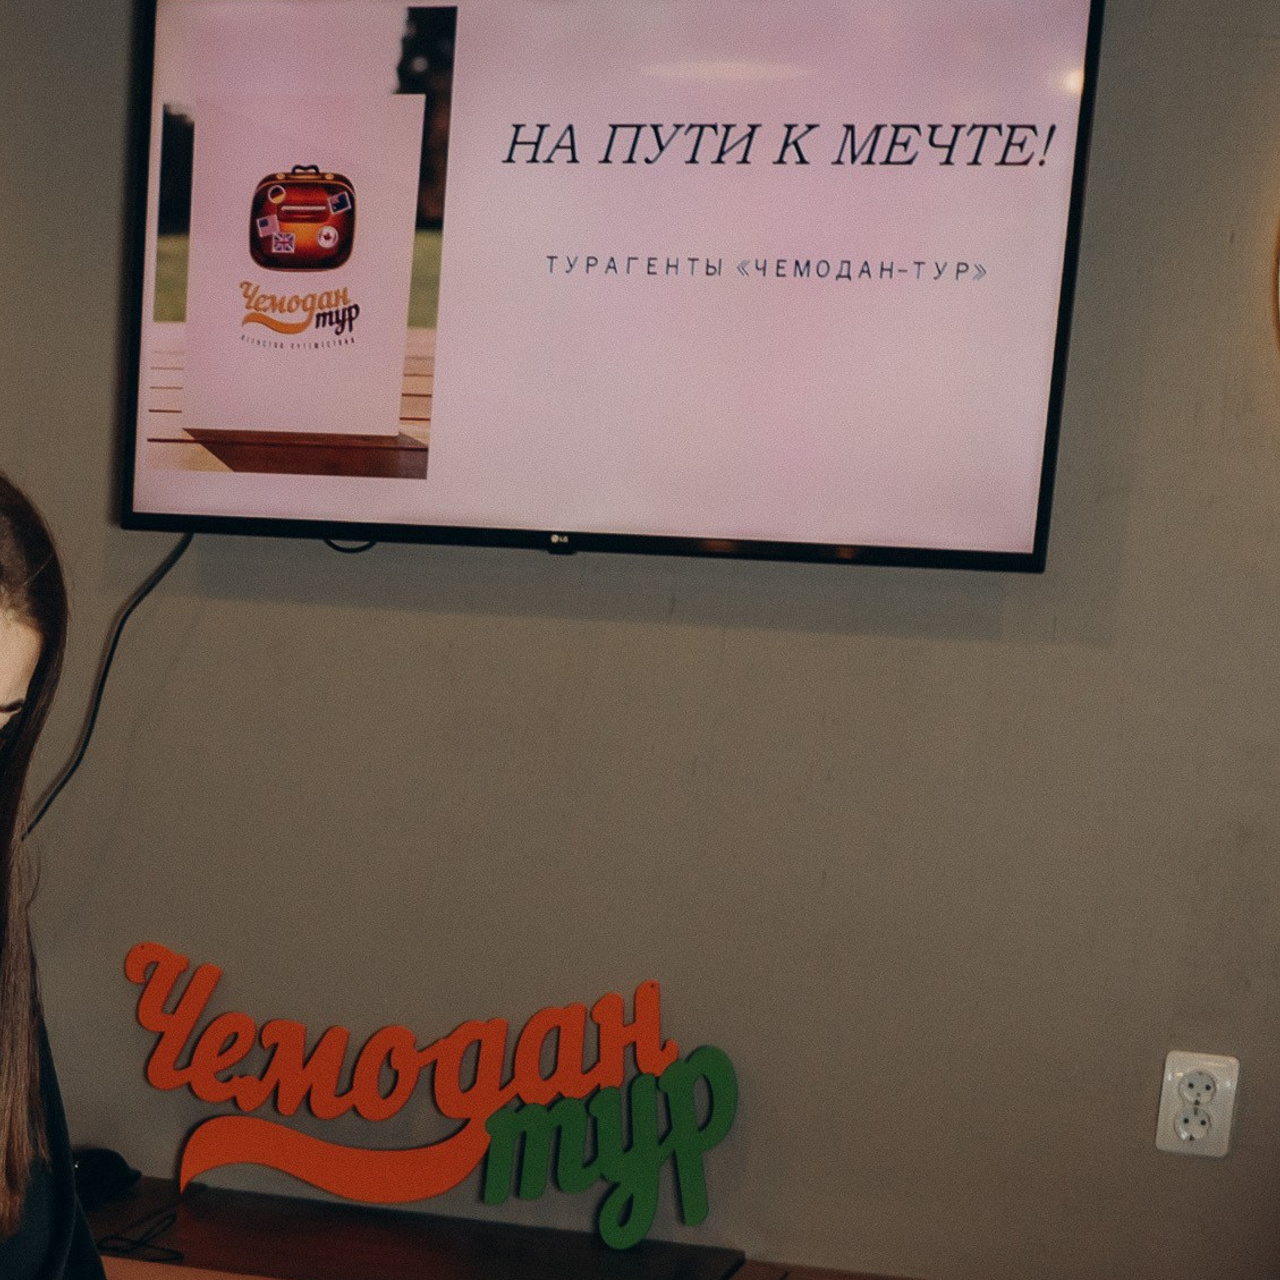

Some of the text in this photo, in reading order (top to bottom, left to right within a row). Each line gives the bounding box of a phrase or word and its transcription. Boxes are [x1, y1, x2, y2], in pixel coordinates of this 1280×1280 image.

[502, 123, 1058, 167] НА ПУТИ К МЕЧТЕ!
[546, 254, 989, 281] ТУРАГЕНТЫ «ЧЕМОДАН-ТУР»
[239, 280, 352, 334] Чемодан
[314, 303, 361, 336] тур
[124, 941, 678, 1204] Чемодан
[484, 1045, 738, 1250] тур
